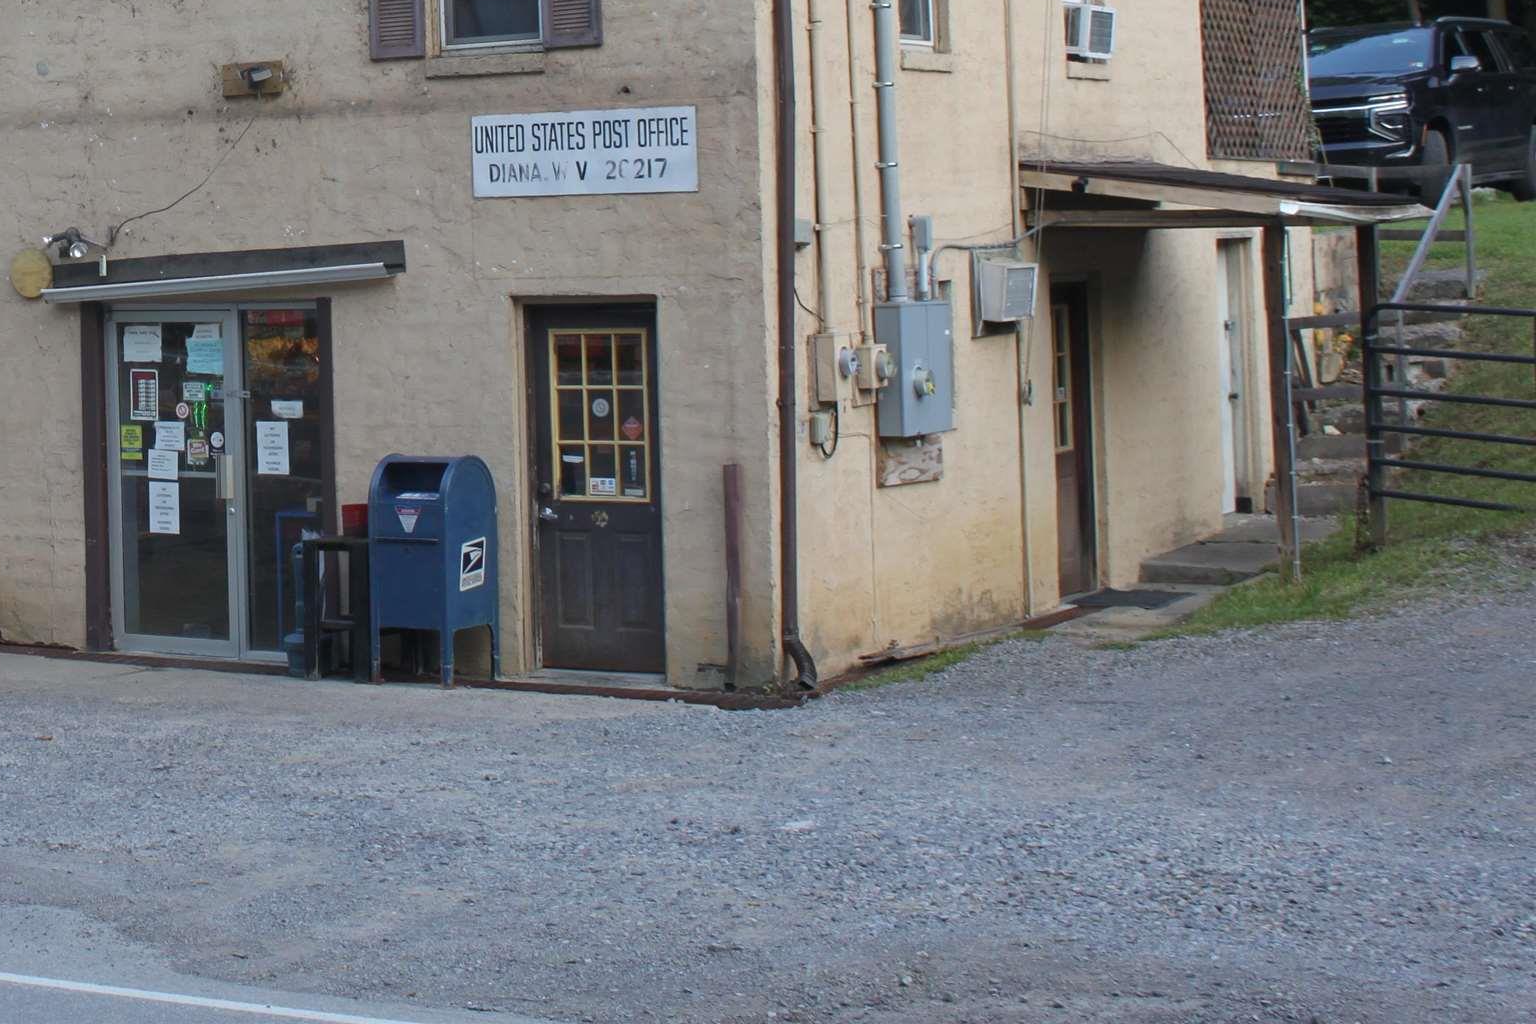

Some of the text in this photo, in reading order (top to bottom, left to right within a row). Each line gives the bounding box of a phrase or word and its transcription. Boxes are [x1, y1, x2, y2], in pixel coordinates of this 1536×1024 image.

[474, 116, 689, 154] UNITED STATES POST OFFICE
